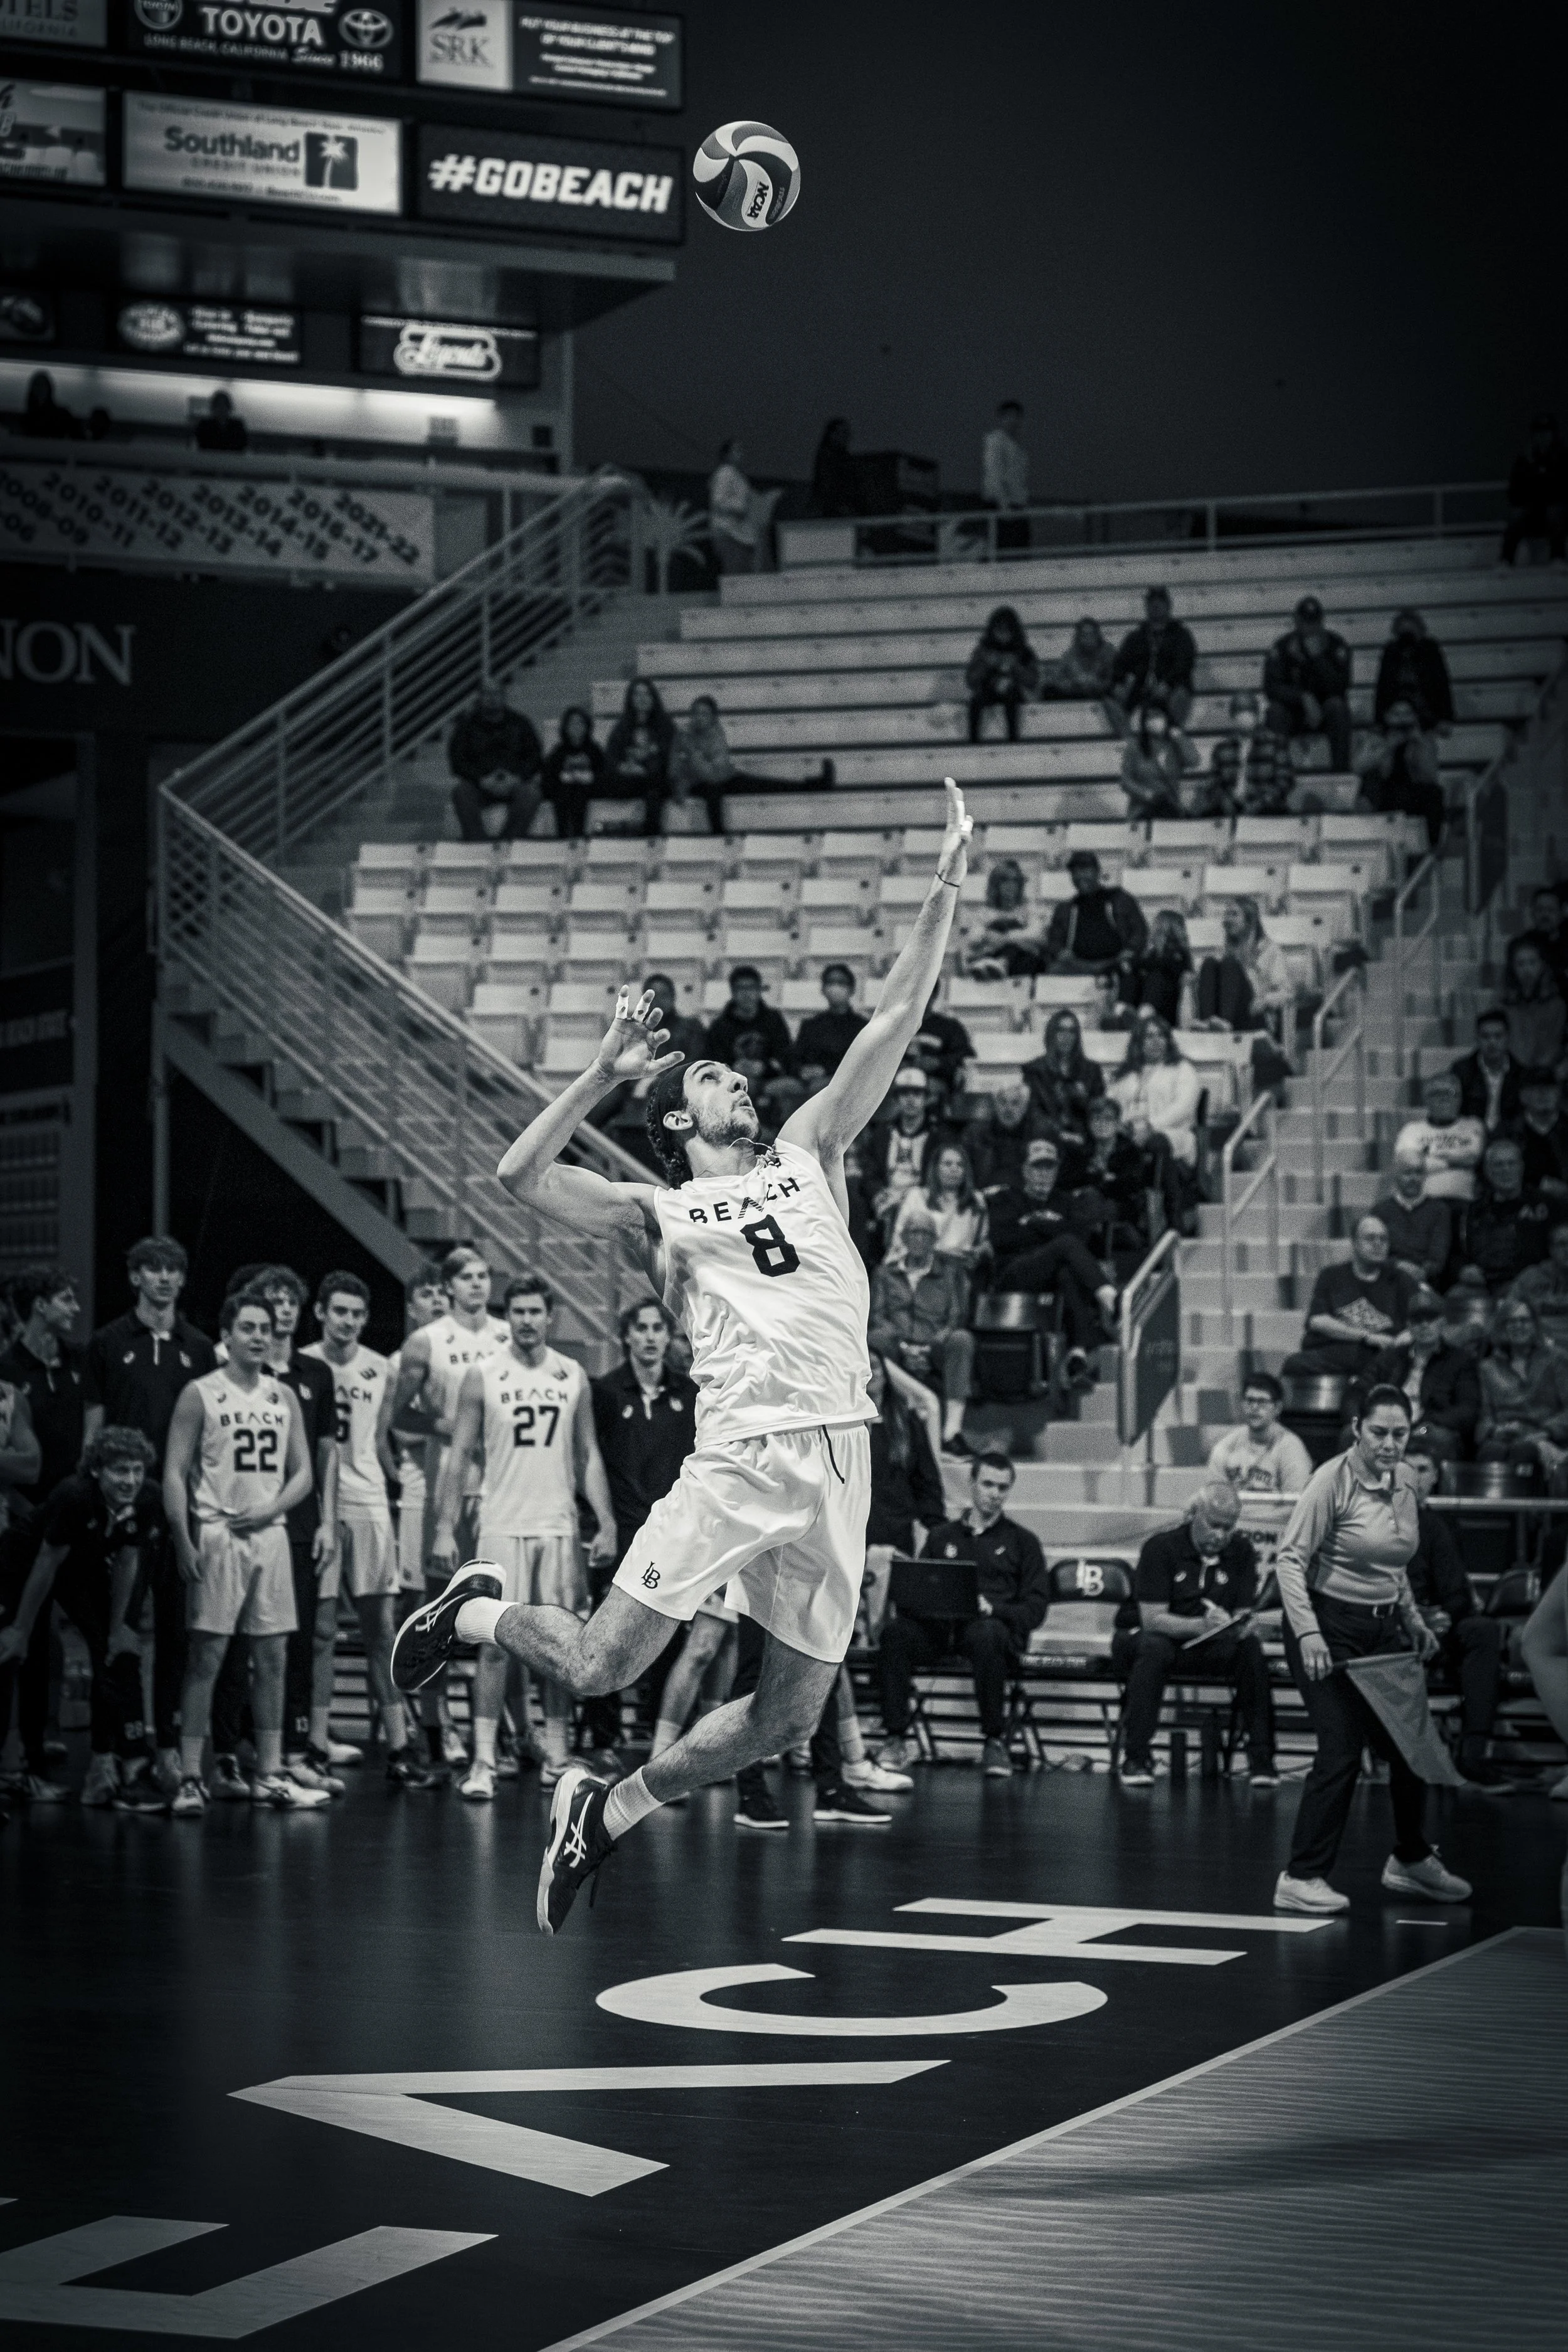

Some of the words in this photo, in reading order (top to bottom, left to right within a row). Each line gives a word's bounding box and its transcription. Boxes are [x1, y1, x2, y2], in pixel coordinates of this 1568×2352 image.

[0, 0, 78, 21] TELS
[200, 6, 324, 46] TOYOTA
[429, 32, 492, 67] SRK
[164, 124, 301, 164] Southland
[427, 152, 674, 214] #GOBEACH
[746, 181, 770, 219] NCAA
[41, 472, 138, 550] 2010-11
[93, 475, 186, 552] 2011-12
[141, 479, 235, 556] 2012-13
[192, 484, 284, 559] 2013-14
[237, 486, 332, 560] 2014-15
[287, 489, 380, 564] 2016-17
[334, 492, 420, 566] 2021-22
[689, 1177, 801, 1224] BEACH
[739, 1214, 801, 1278] 8
[336, 1385, 373, 1403] ACH
[500, 1388, 568, 1404] BEACH
[220, 1411, 283, 1427] BEACH
[512, 1405, 560, 1447] 27
[233, 1428, 278, 1473] 22
[640, 1560, 661, 1590] LB
